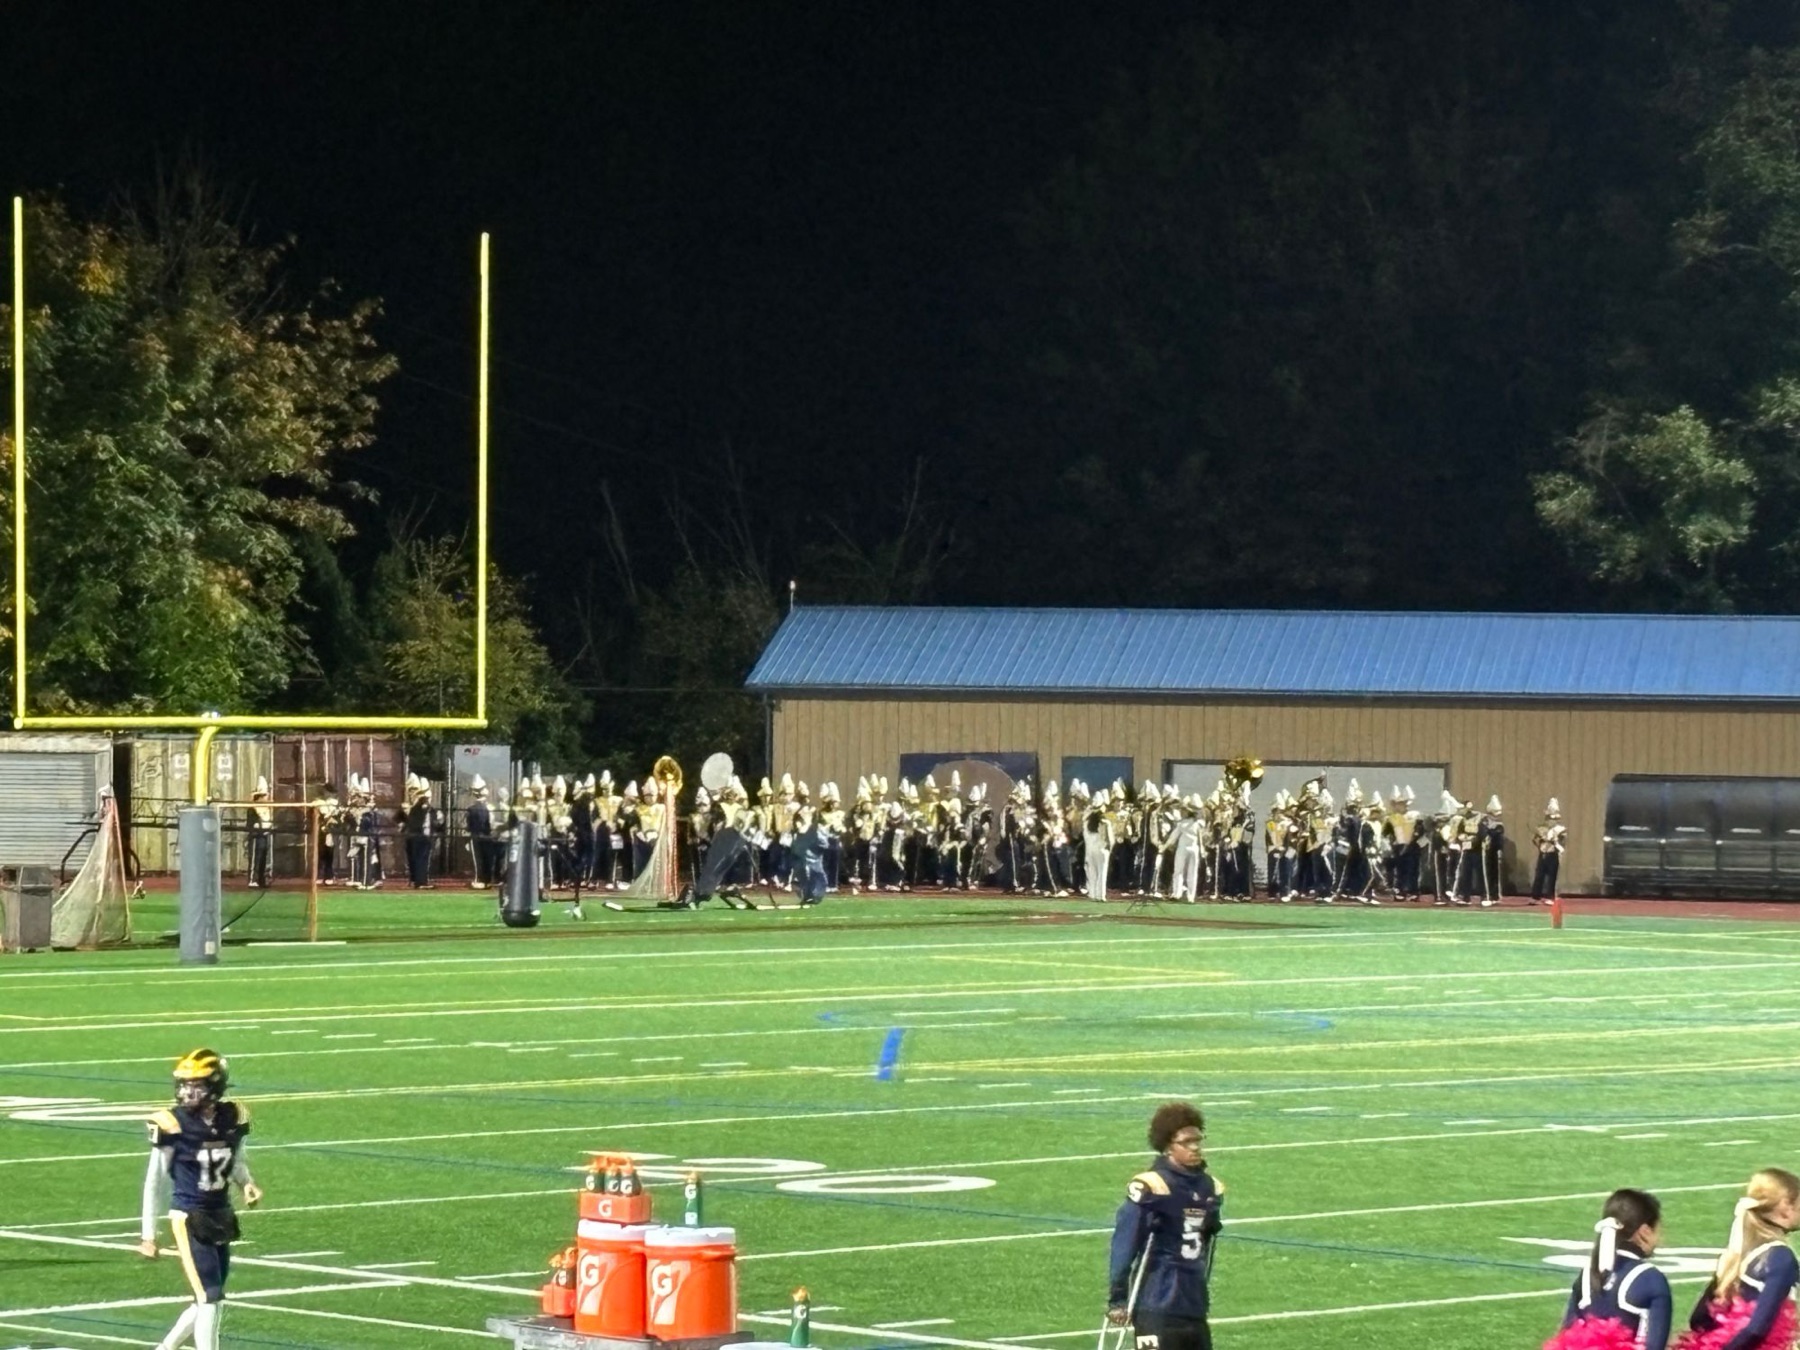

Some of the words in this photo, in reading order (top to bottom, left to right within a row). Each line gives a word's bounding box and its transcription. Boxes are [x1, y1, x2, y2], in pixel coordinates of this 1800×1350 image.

[196, 1147, 232, 1191] 17
[620, 1179, 632, 1194] G
[1127, 1181, 1144, 1203] 5
[598, 1200, 612, 1217] G
[1181, 1216, 1204, 1260] 5
[580, 1253, 600, 1287] G
[651, 1264, 673, 1298] G
